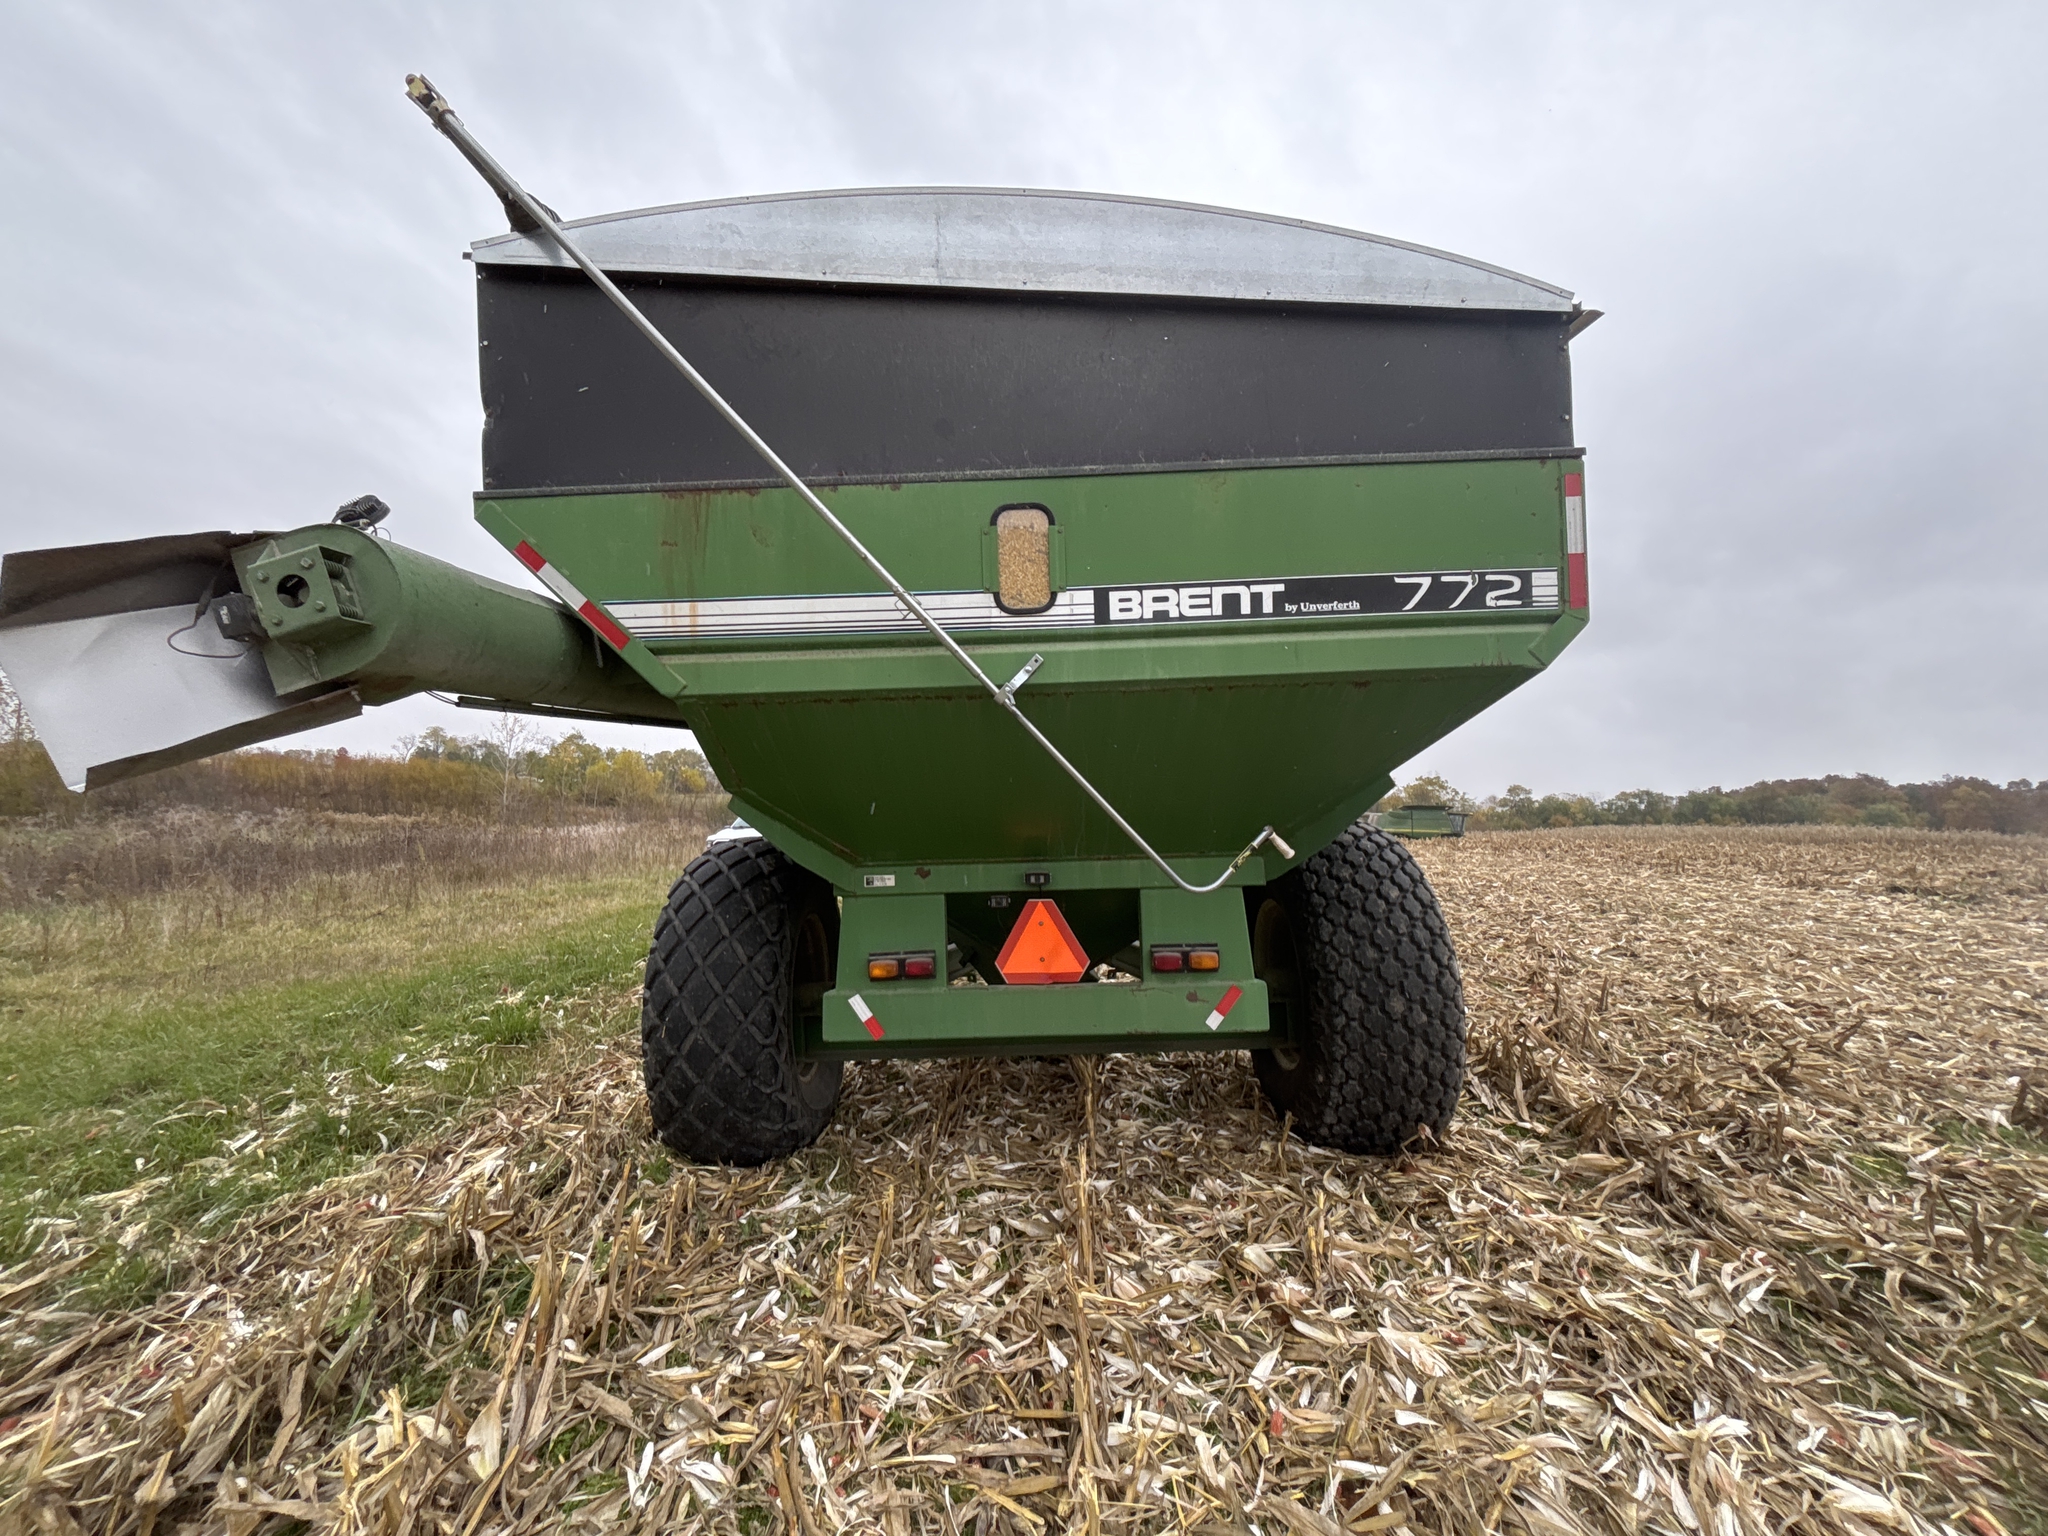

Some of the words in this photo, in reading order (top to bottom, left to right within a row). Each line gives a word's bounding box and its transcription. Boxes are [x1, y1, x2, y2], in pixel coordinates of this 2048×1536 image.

[1108, 583, 1285, 621] BRENT
[1284, 602, 1299, 613] by
[1300, 600, 1361, 612] Unverferth
[1393, 573, 1523, 611] 772
